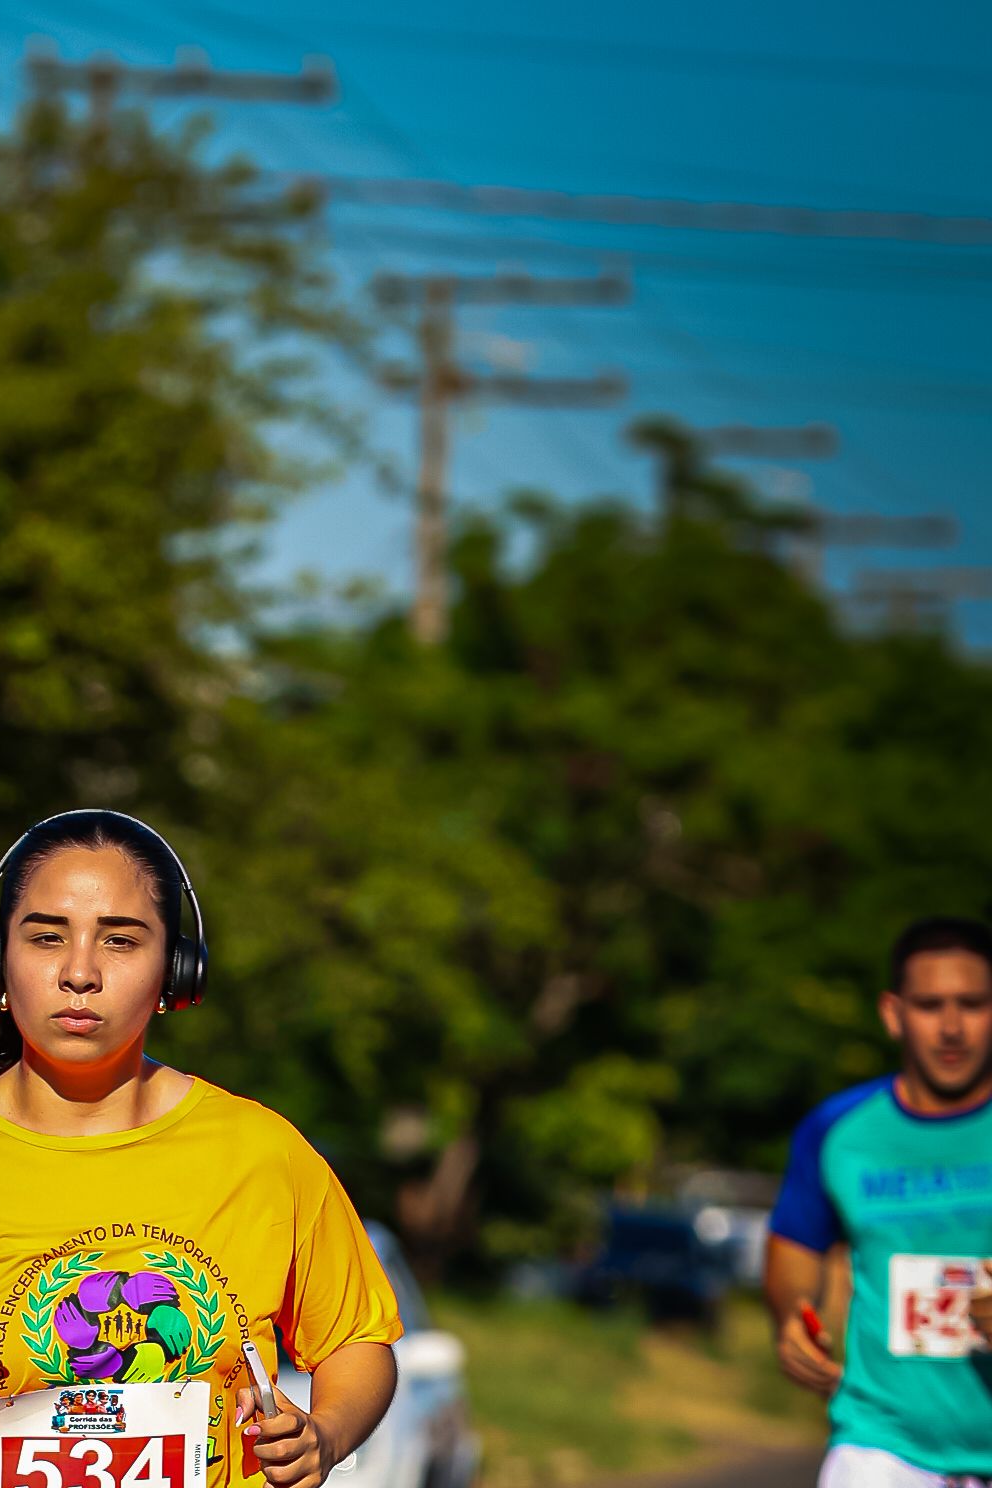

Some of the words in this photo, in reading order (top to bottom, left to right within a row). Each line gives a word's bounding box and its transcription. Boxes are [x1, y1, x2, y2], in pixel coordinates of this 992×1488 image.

[0, 1226, 107, 1316] ENCERRAMENTO
[112, 1223, 136, 1238] DA
[141, 1223, 229, 1289] TEMPORADA
[194, 1444, 202, 1476] MEDALHA
